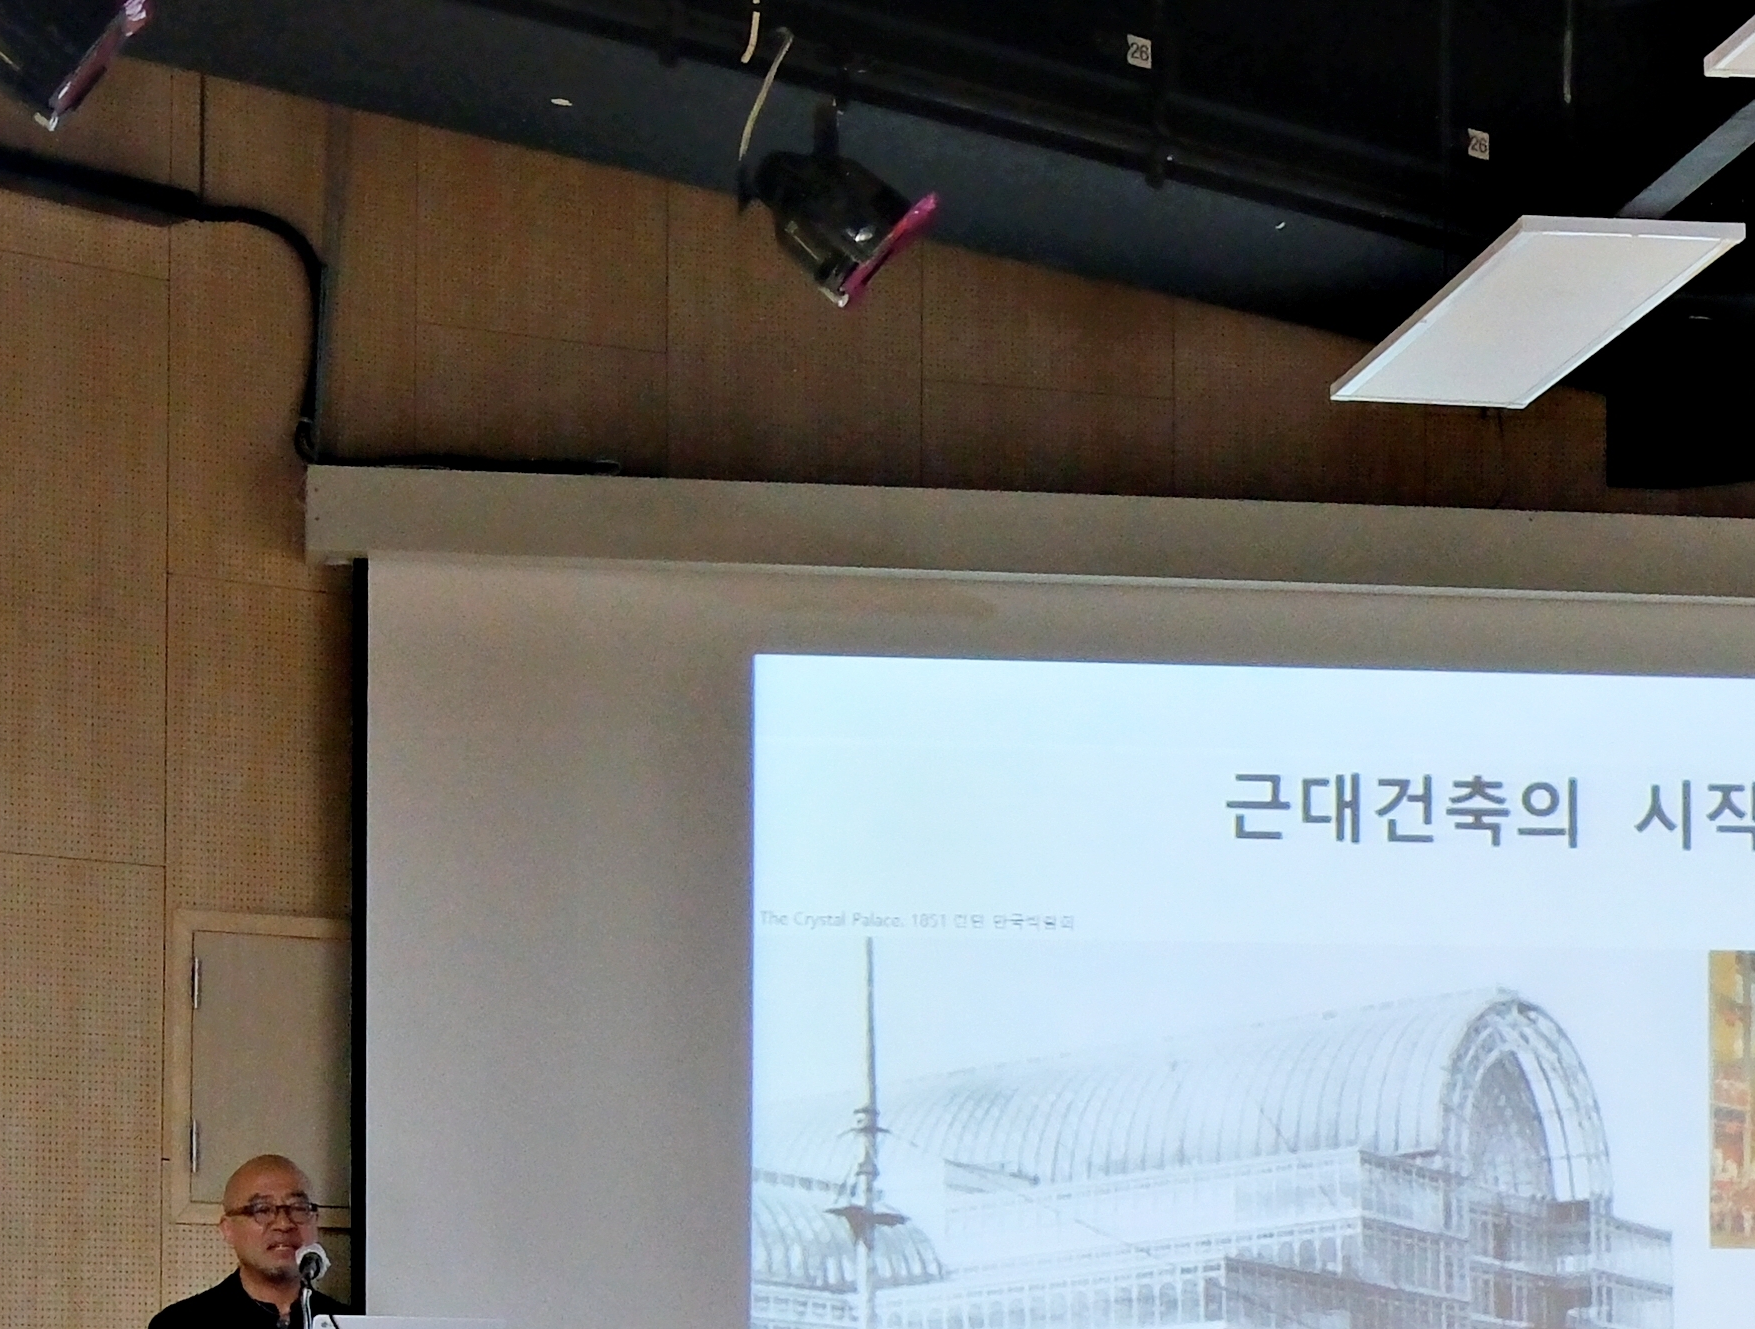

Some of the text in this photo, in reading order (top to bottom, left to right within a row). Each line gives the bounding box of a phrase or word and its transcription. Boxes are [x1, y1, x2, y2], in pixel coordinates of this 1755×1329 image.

[1130, 42, 1149, 61] 26
[1226, 773, 1578, 850] 근대건축의
[760, 910, 788, 926] The
[794, 910, 846, 929] Crystal
